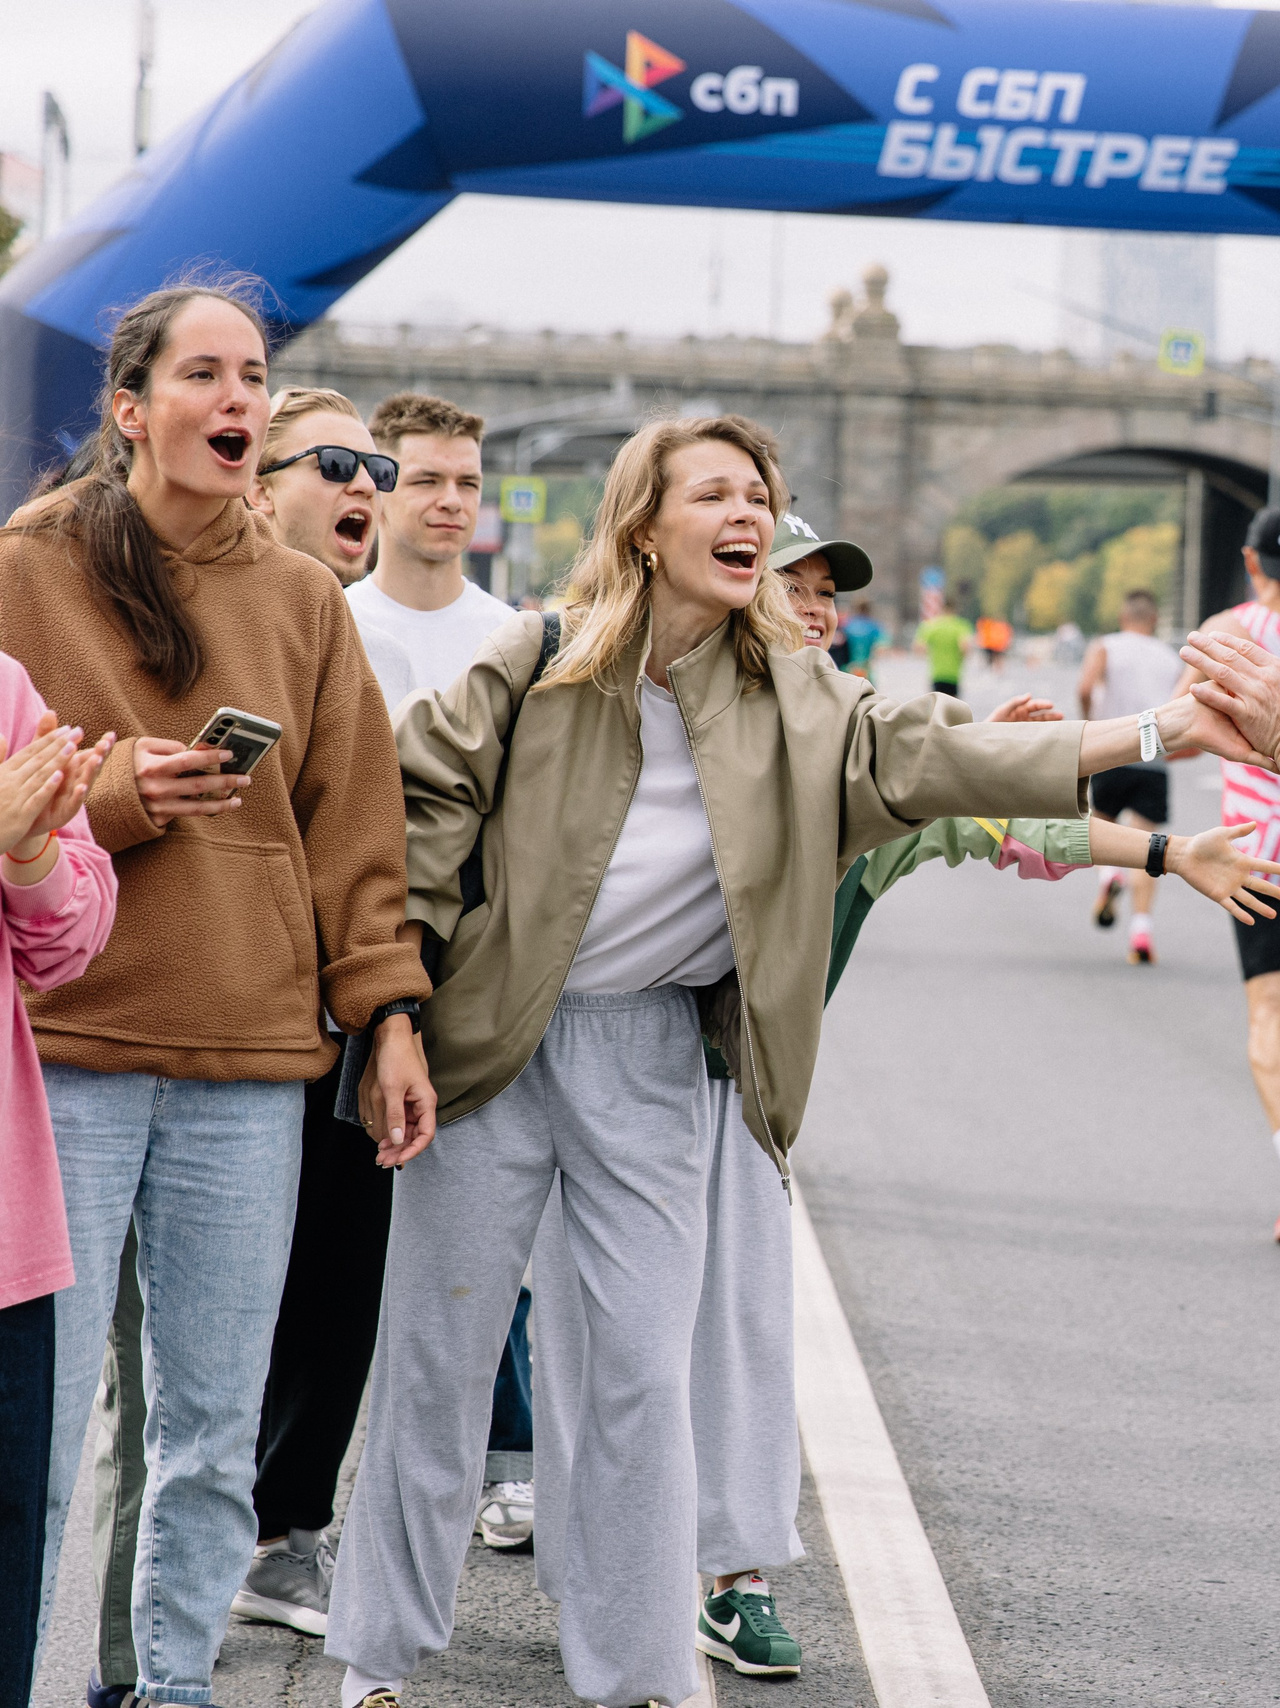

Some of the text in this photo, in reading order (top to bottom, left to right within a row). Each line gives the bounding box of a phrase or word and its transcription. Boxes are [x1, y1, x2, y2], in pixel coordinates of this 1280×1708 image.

[690, 65, 800, 117] сбп
[893, 63, 1088, 124] С СБП
[876, 119, 1240, 195] БЫСТРЕЕ
